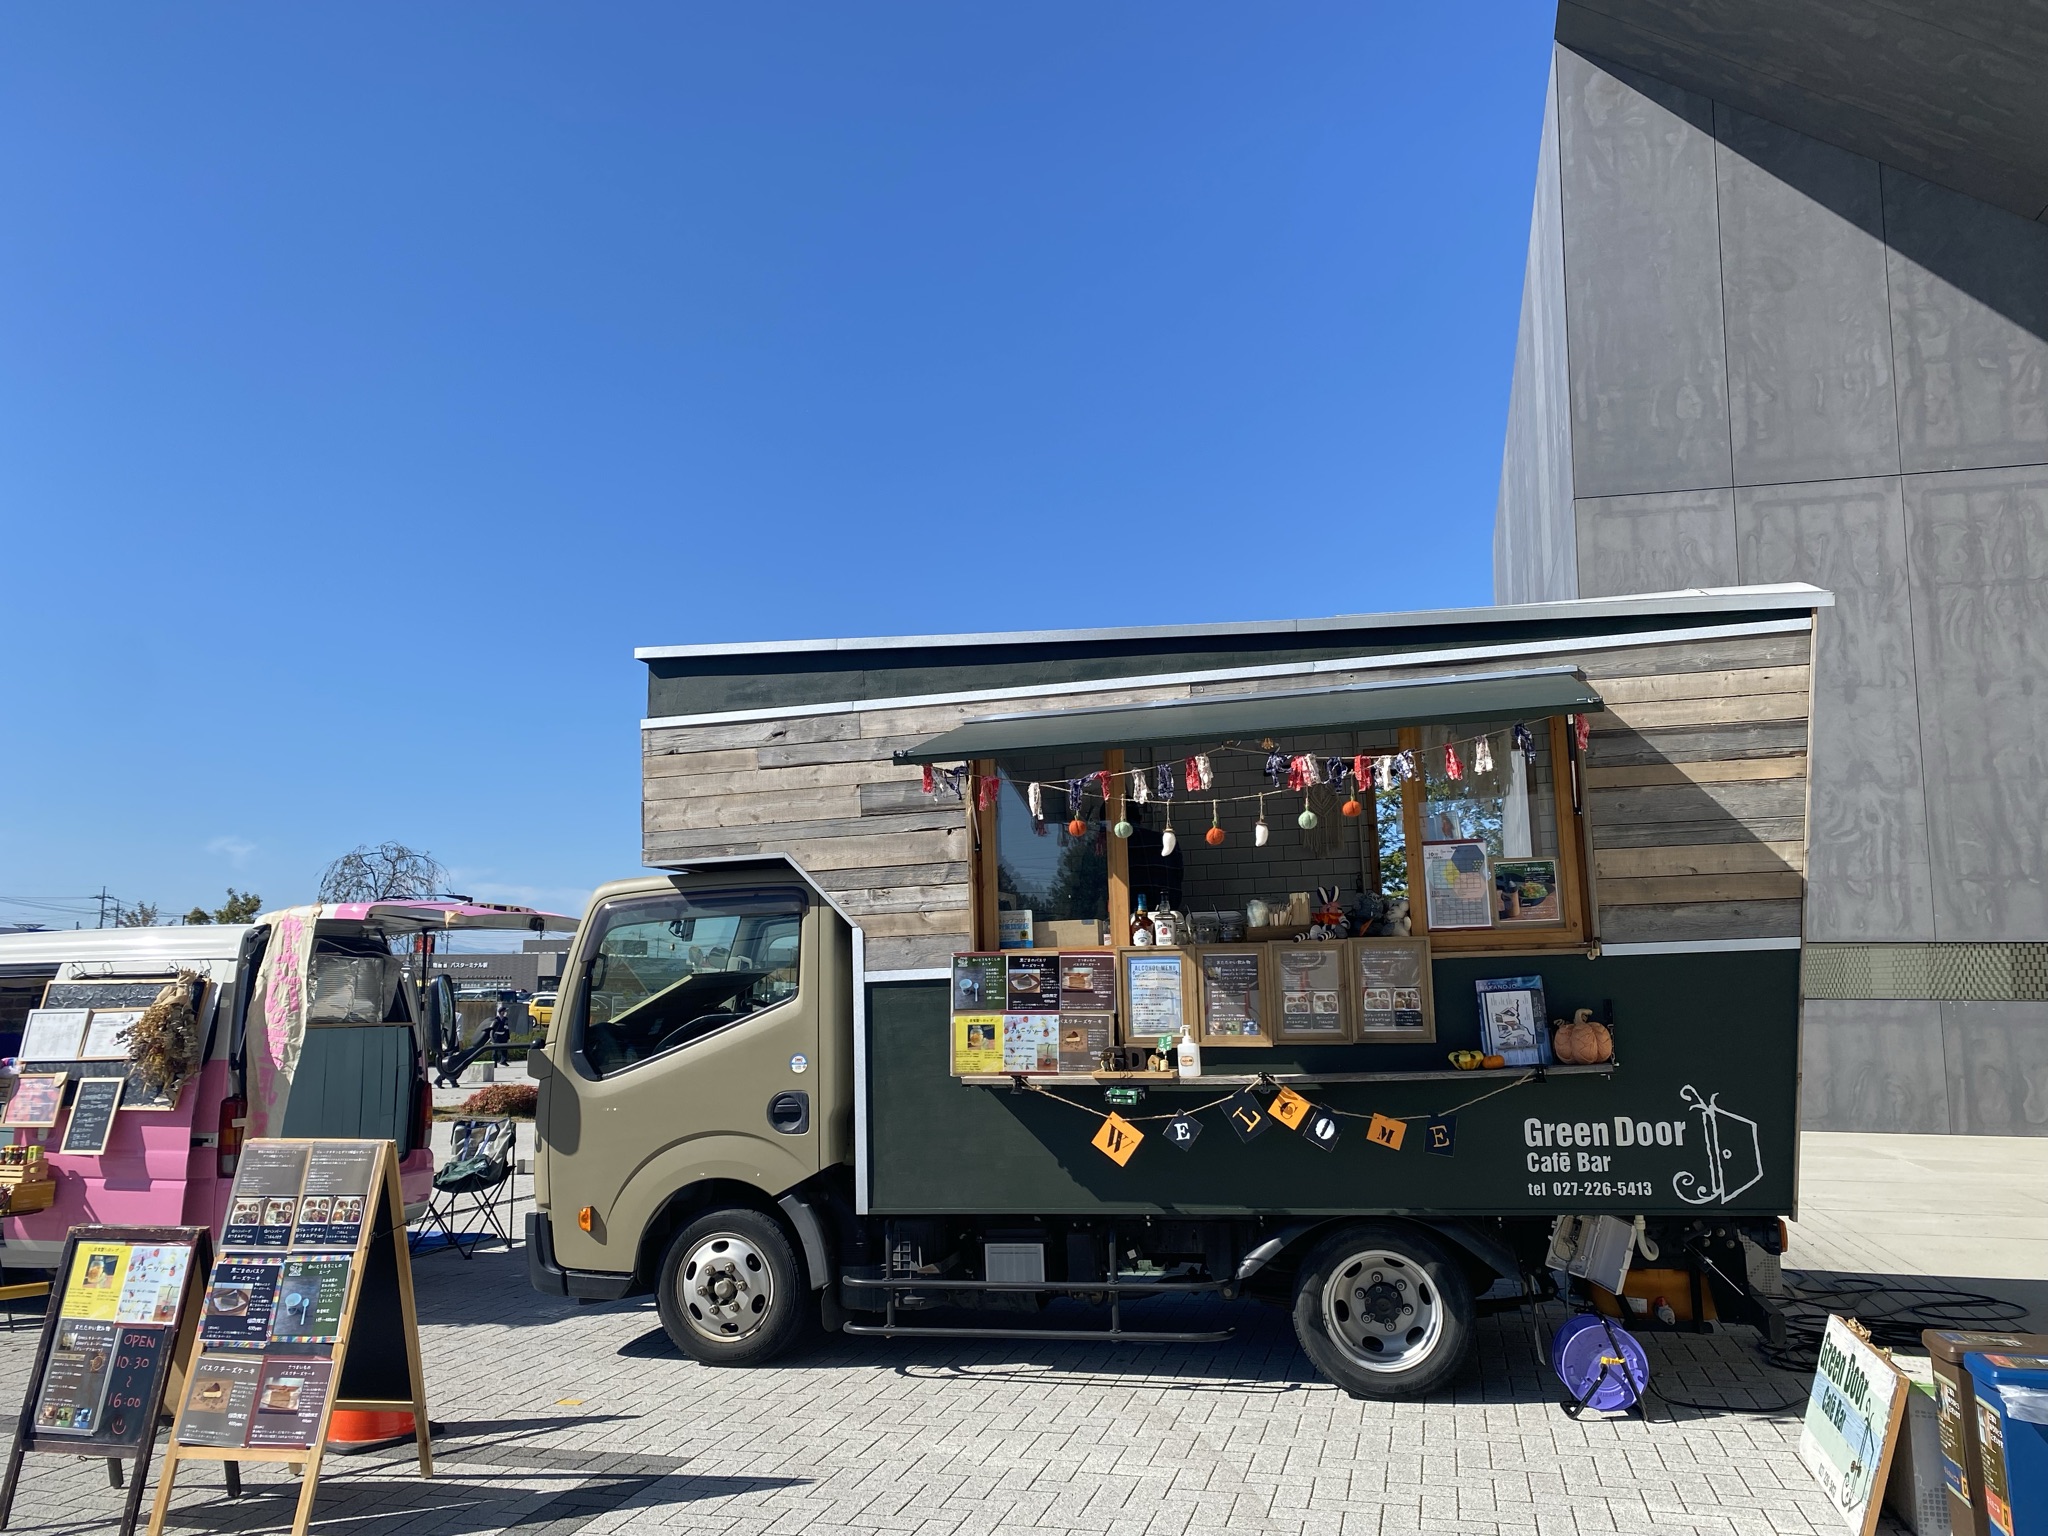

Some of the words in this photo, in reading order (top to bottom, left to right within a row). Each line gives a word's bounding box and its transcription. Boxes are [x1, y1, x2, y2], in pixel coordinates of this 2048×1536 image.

[1524, 1117, 1609, 1147] Green
[1614, 1116, 1686, 1147] Door
[1577, 1152, 1611, 1172] Bar
[1528, 1182, 1546, 1196] tel
[1553, 1181, 1653, 1197] 027-226-5413
[123, 1334, 156, 1348] OPEN
[116, 1355, 149, 1370] 10:30
[200, 1364, 255, 1375] バスクチーズケーキ
[1820, 1332, 1846, 1387] Green
[1843, 1353, 1870, 1411] Door
[108, 1392, 141, 1408] 16:00
